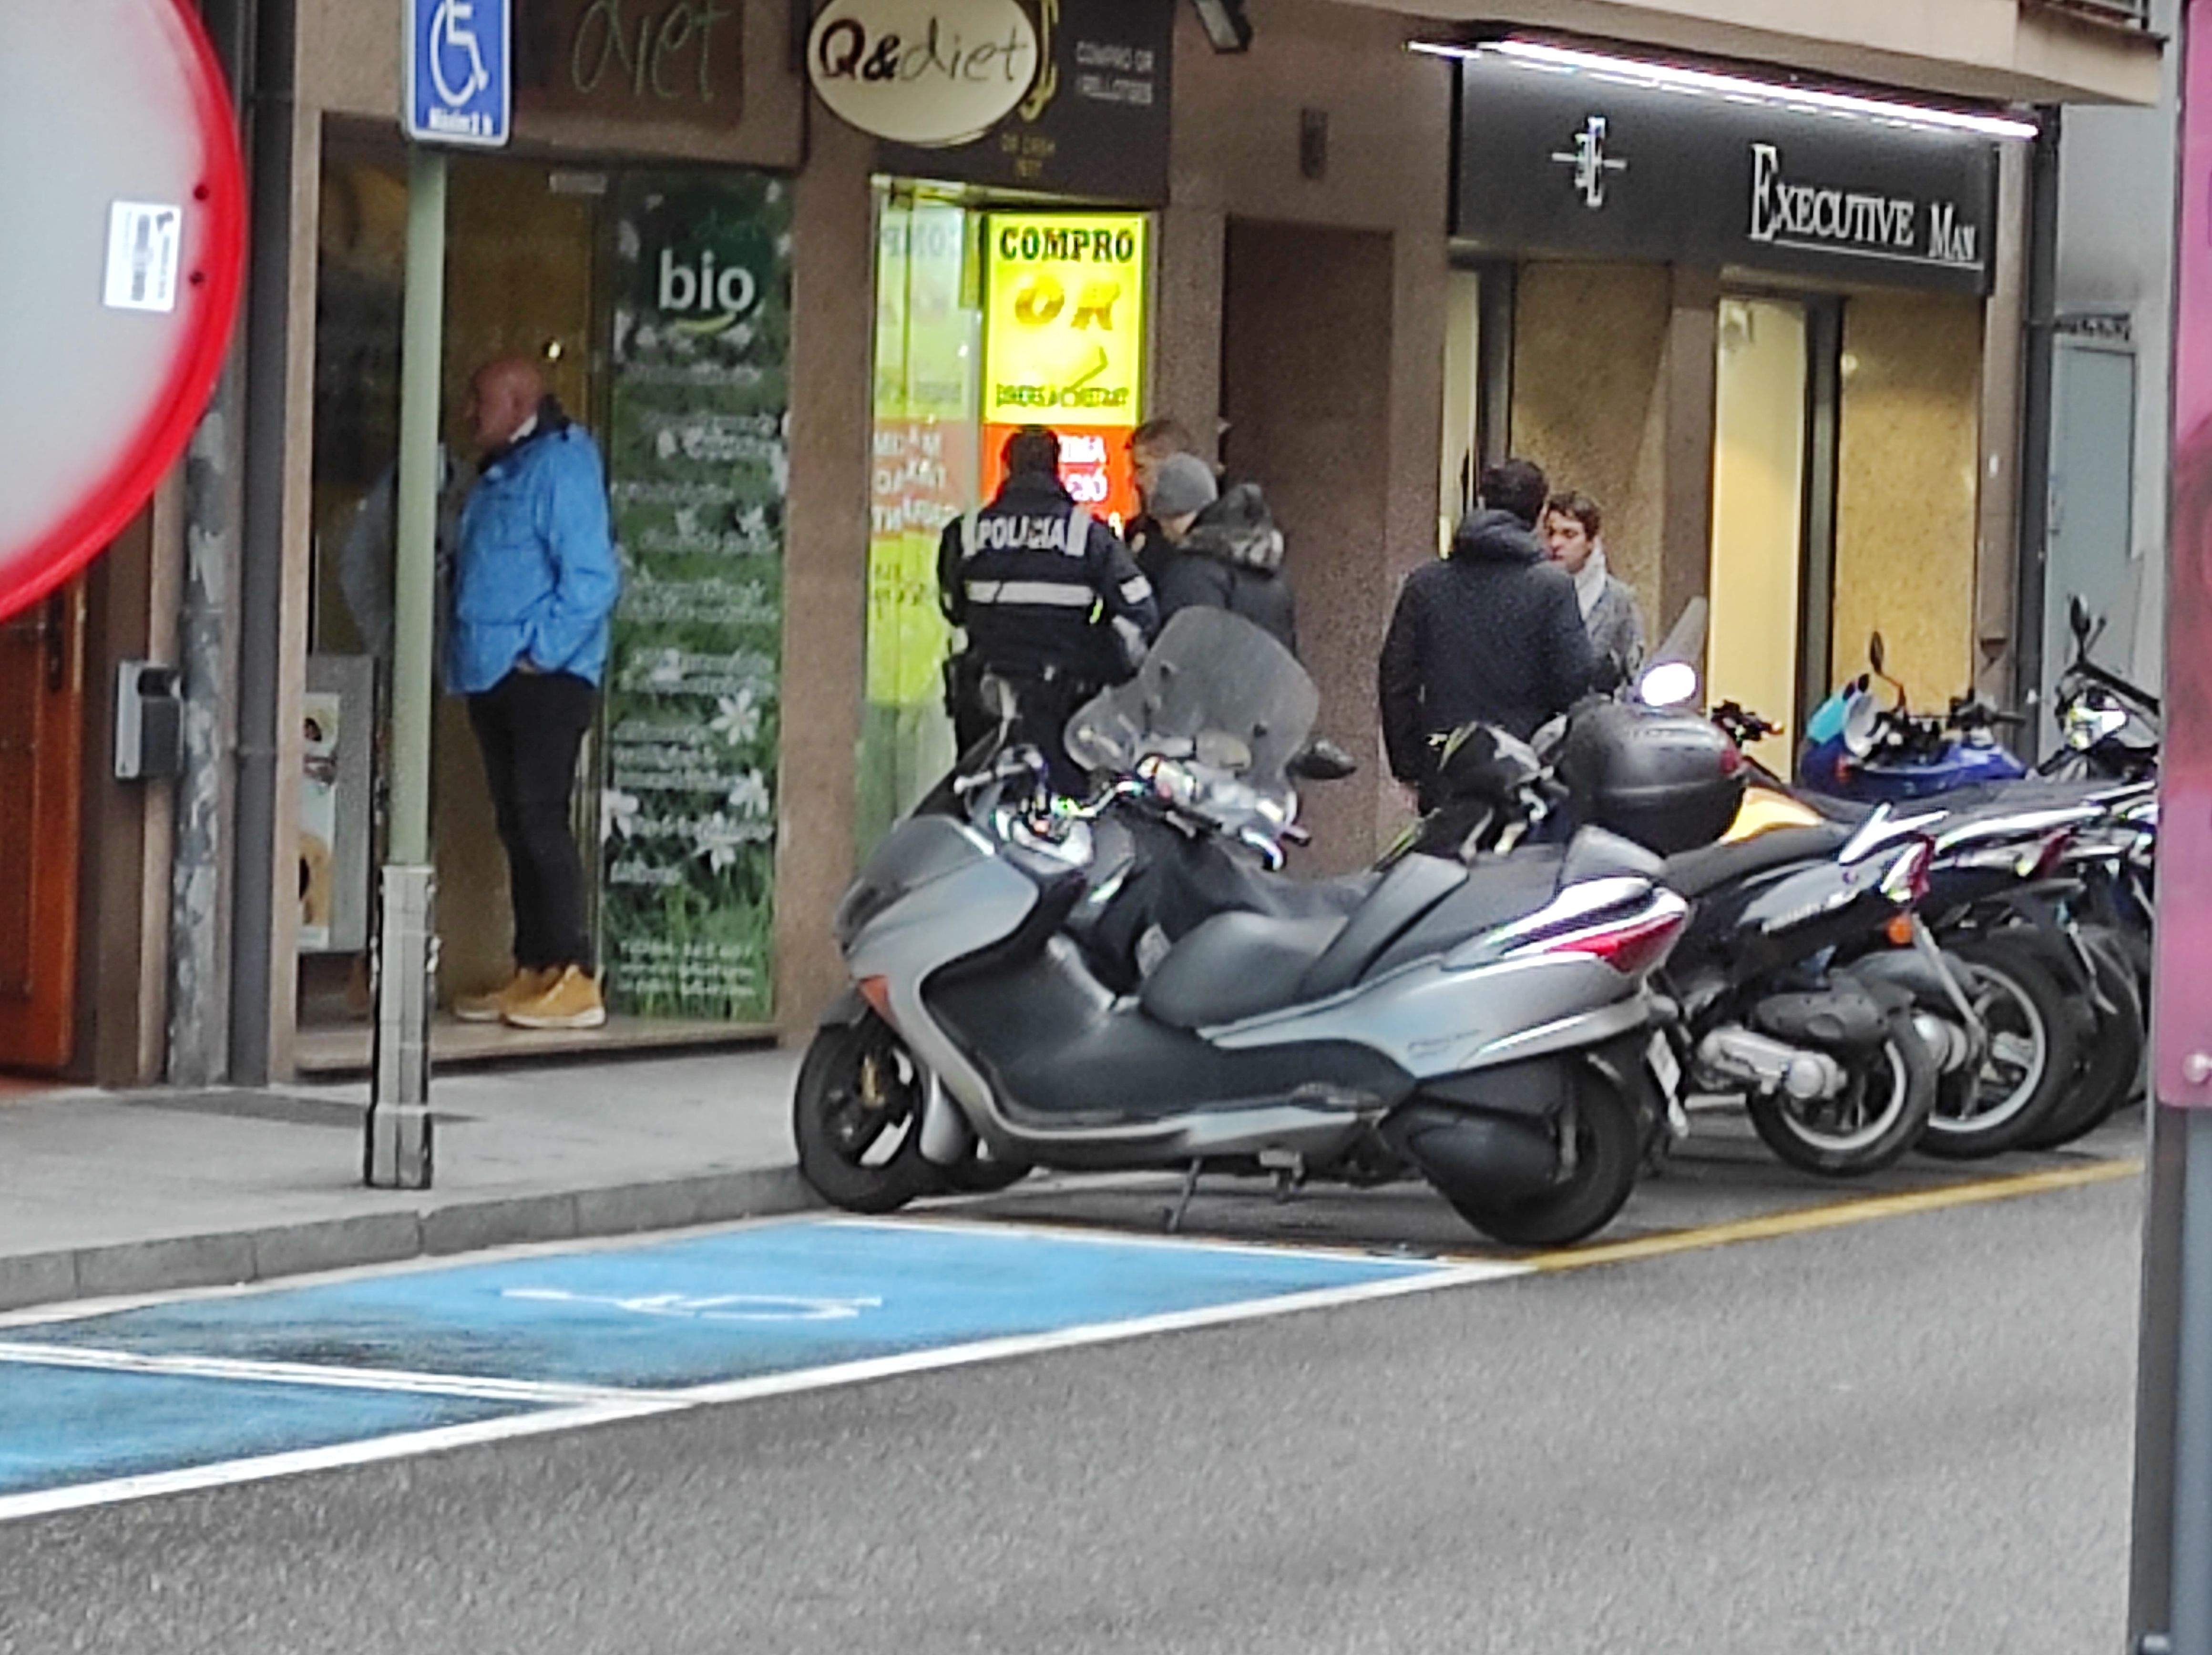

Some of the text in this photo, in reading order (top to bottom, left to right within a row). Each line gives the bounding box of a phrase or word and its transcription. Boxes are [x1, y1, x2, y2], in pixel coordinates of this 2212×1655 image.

[1750, 143, 1915, 246] EXECUTIVE
[1000, 226, 1134, 263] COMPRO
[658, 248, 755, 311] bio
